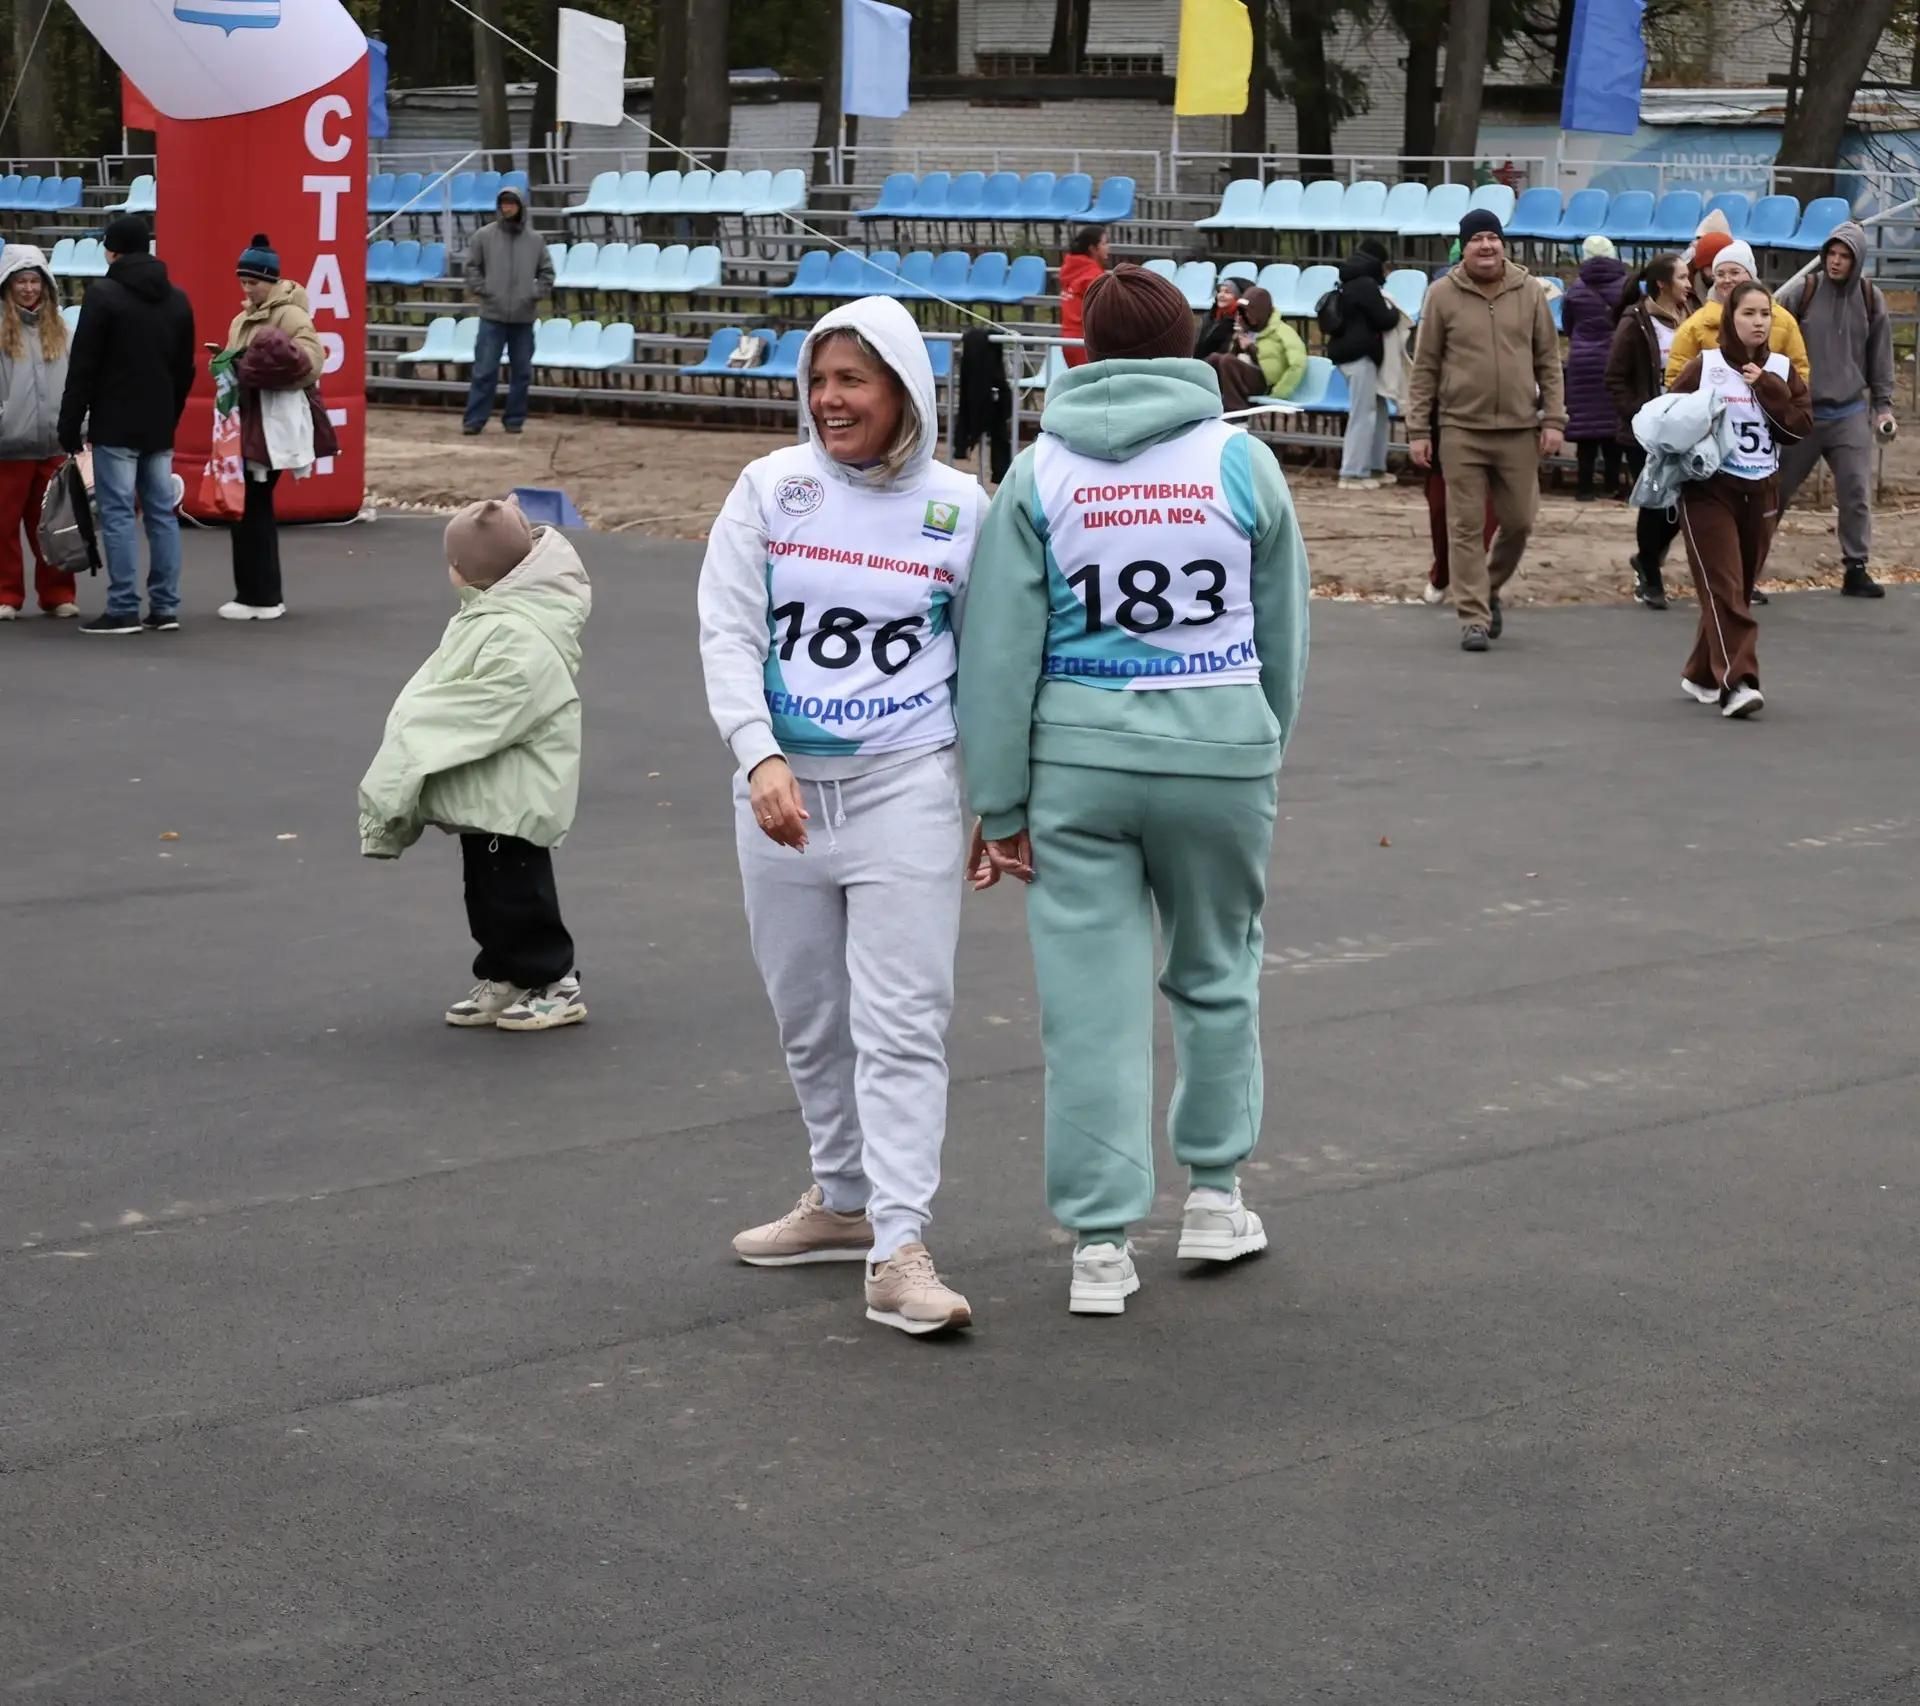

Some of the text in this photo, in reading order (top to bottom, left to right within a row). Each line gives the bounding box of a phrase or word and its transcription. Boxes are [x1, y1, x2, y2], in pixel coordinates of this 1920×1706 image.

[1661, 152, 1774, 182] UNIVERS
[1073, 483, 1214, 504] СПОРТИВНАЯ
[1083, 507, 1206, 529] ШКОЛА №4
[767, 540, 864, 566] ПОРТИВНАЯ
[867, 554, 929, 578] ШКОЛА
[1065, 558, 1228, 634] 183
[772, 601, 925, 676] 186
[1046, 638, 1255, 678] ЕЛЕНОДОЛЬСК
